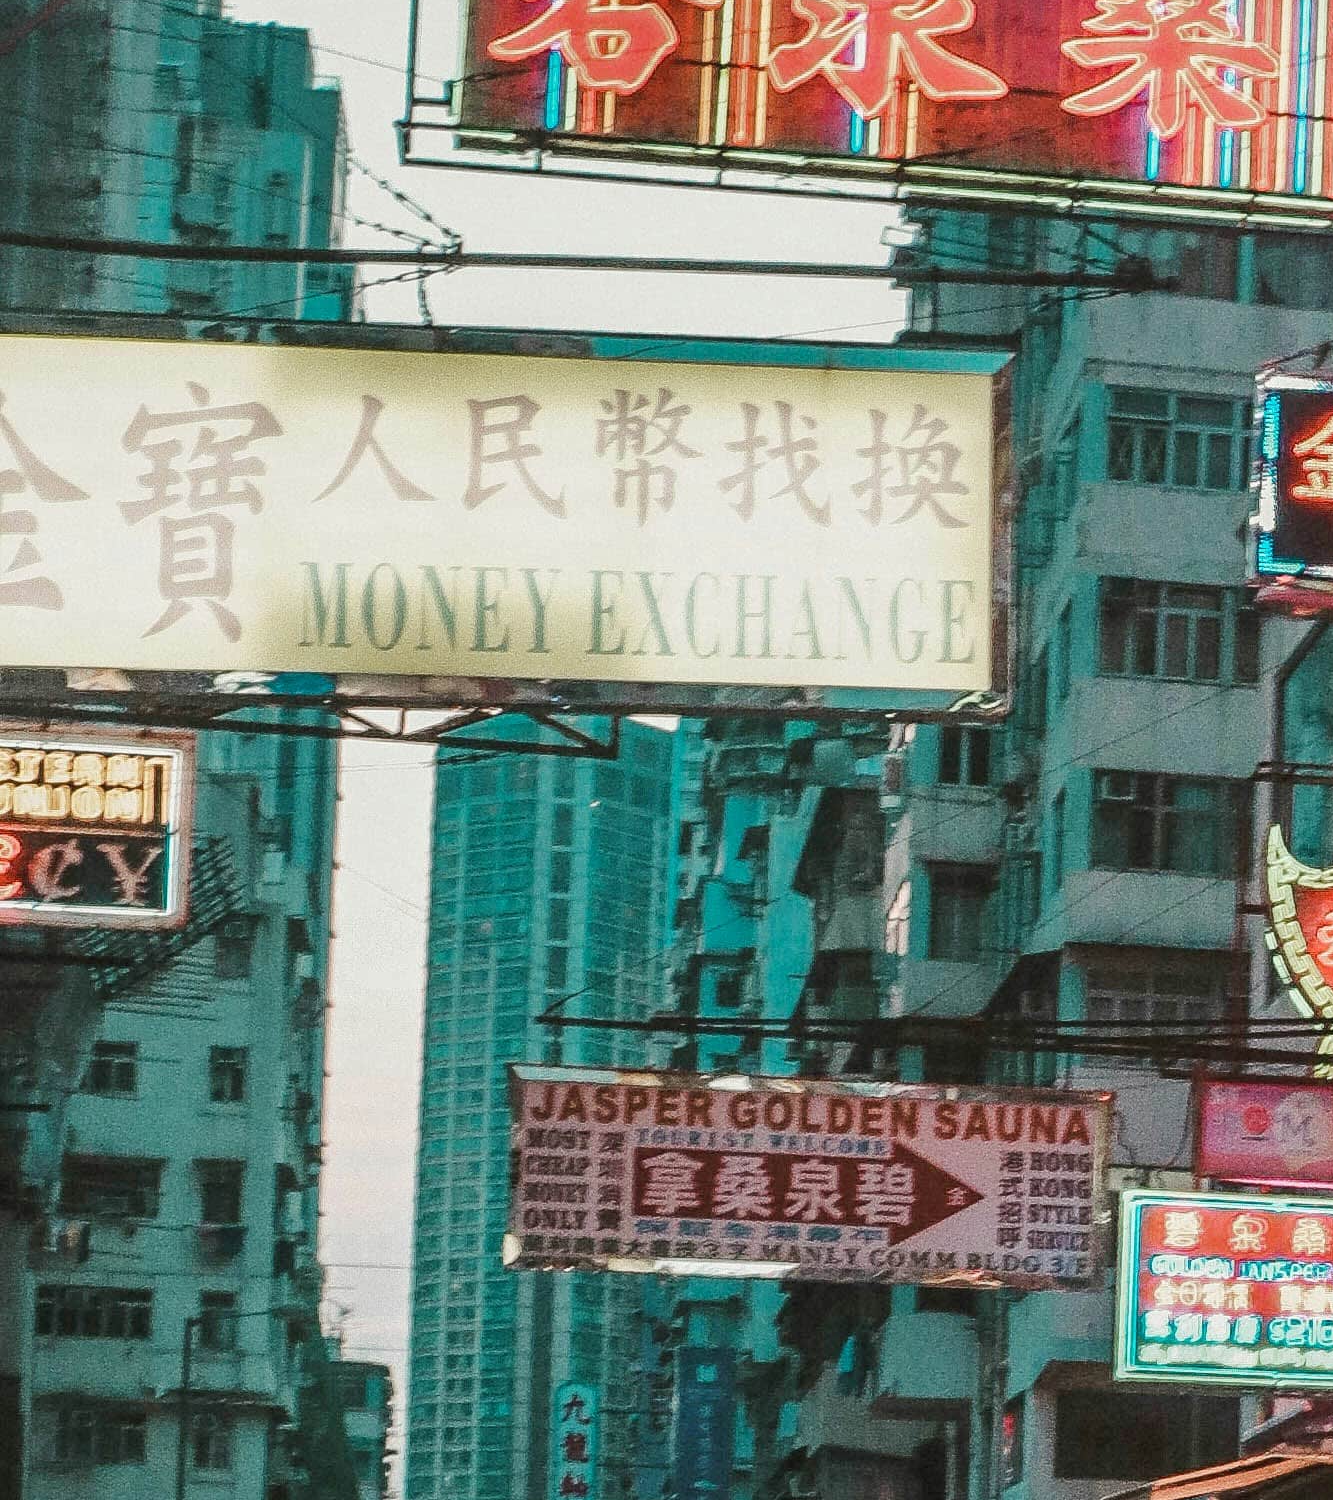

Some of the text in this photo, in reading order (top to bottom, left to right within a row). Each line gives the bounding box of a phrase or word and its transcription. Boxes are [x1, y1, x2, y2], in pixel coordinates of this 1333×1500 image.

[312, 387, 972, 530] 人民幣找換
[299, 559, 976, 667] MONEY EXCHANGE
[529, 1084, 1091, 1146] JASPER GOLDEN SAUNA
